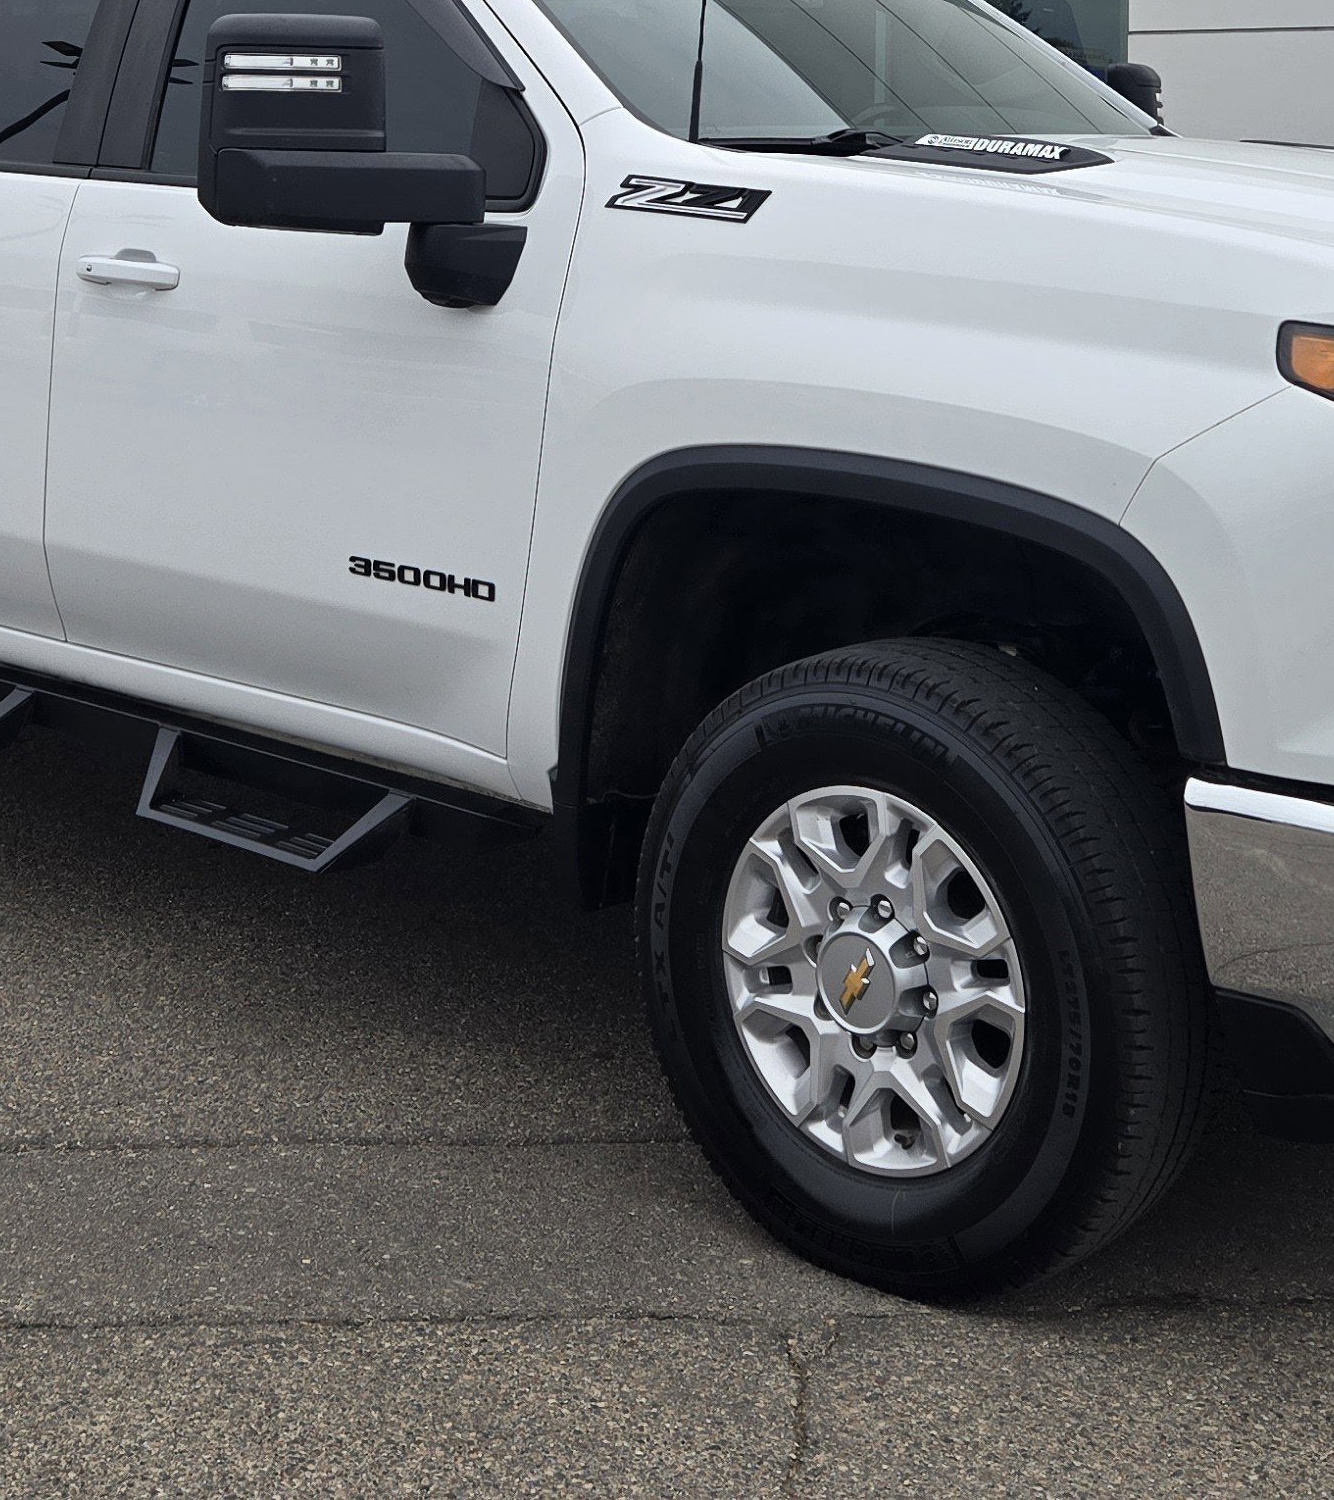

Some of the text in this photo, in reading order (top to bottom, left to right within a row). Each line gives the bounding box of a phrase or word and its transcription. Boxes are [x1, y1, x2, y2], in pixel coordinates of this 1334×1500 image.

[973, 137, 1068, 160] DURAMAX
[605, 174, 773, 224] Z71
[348, 555, 496, 602] 3500HD
